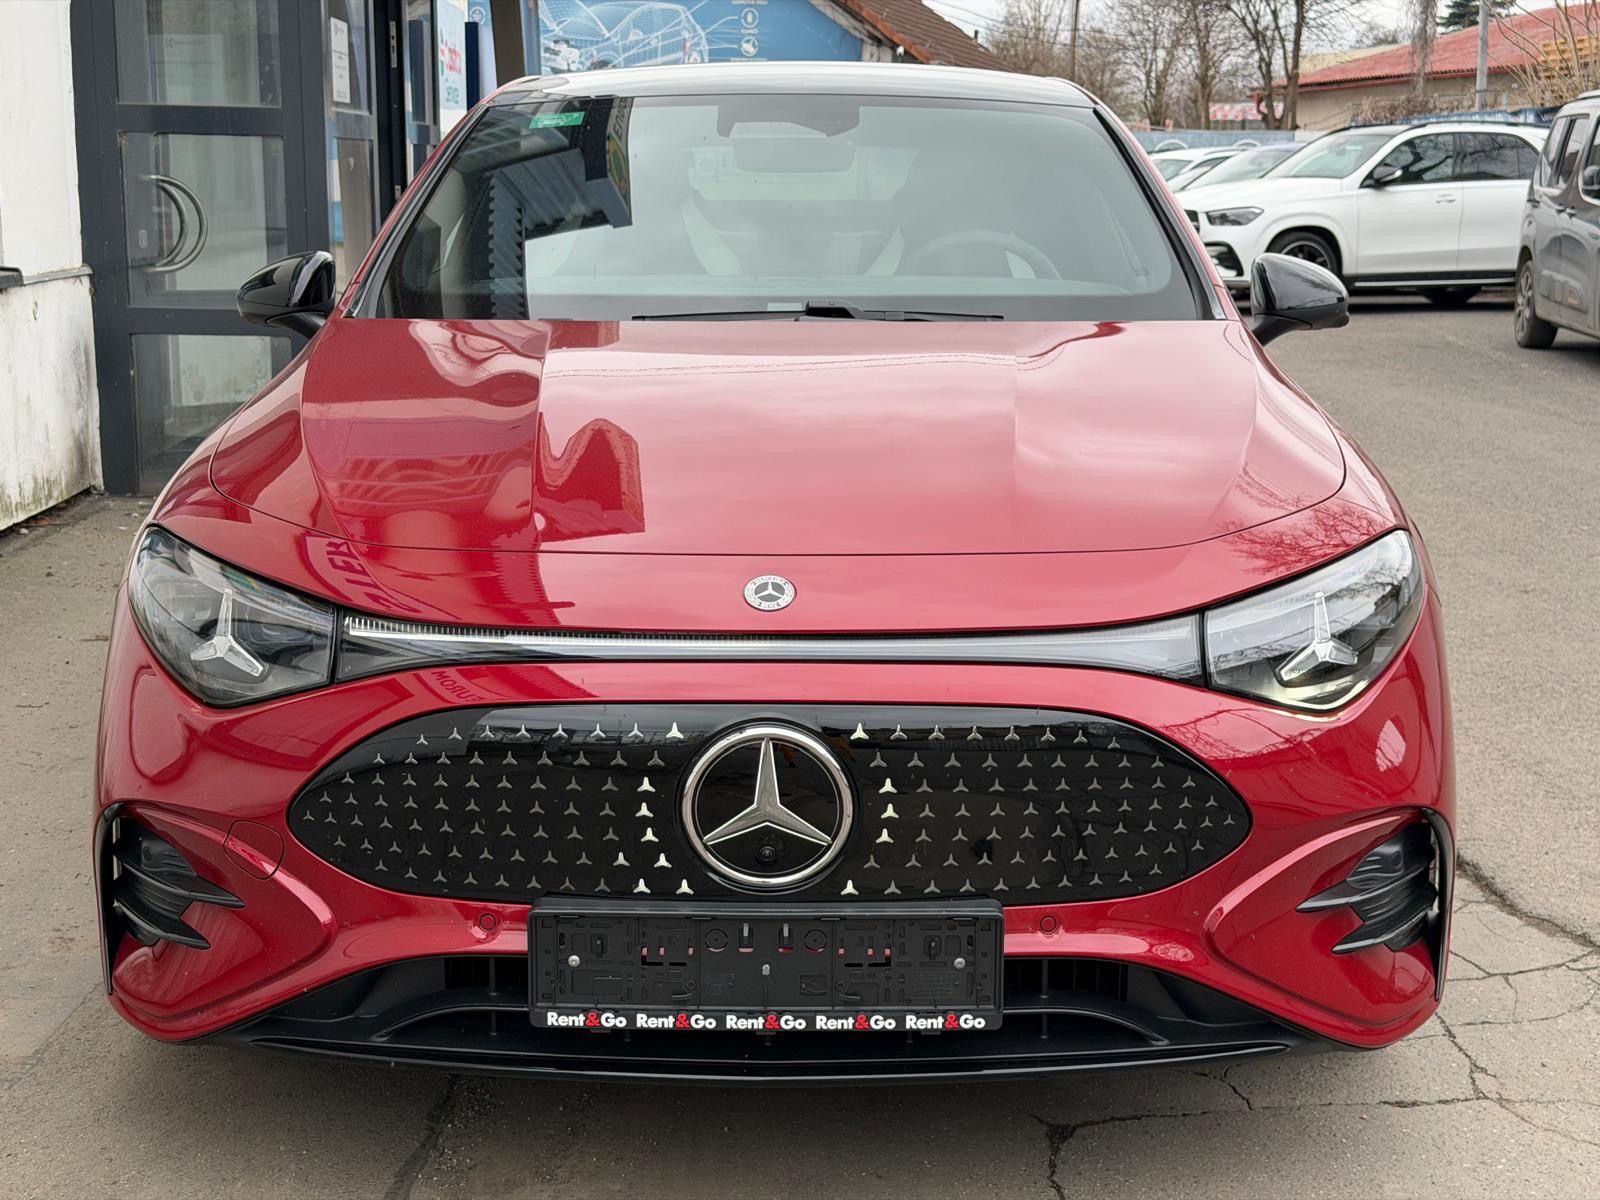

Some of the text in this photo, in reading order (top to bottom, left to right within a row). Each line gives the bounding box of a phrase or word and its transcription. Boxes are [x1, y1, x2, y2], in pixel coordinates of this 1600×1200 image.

[546, 1011, 985, 1029] Rent&Go Rent&Go Rent&Go Rent&Go Rent&Go
